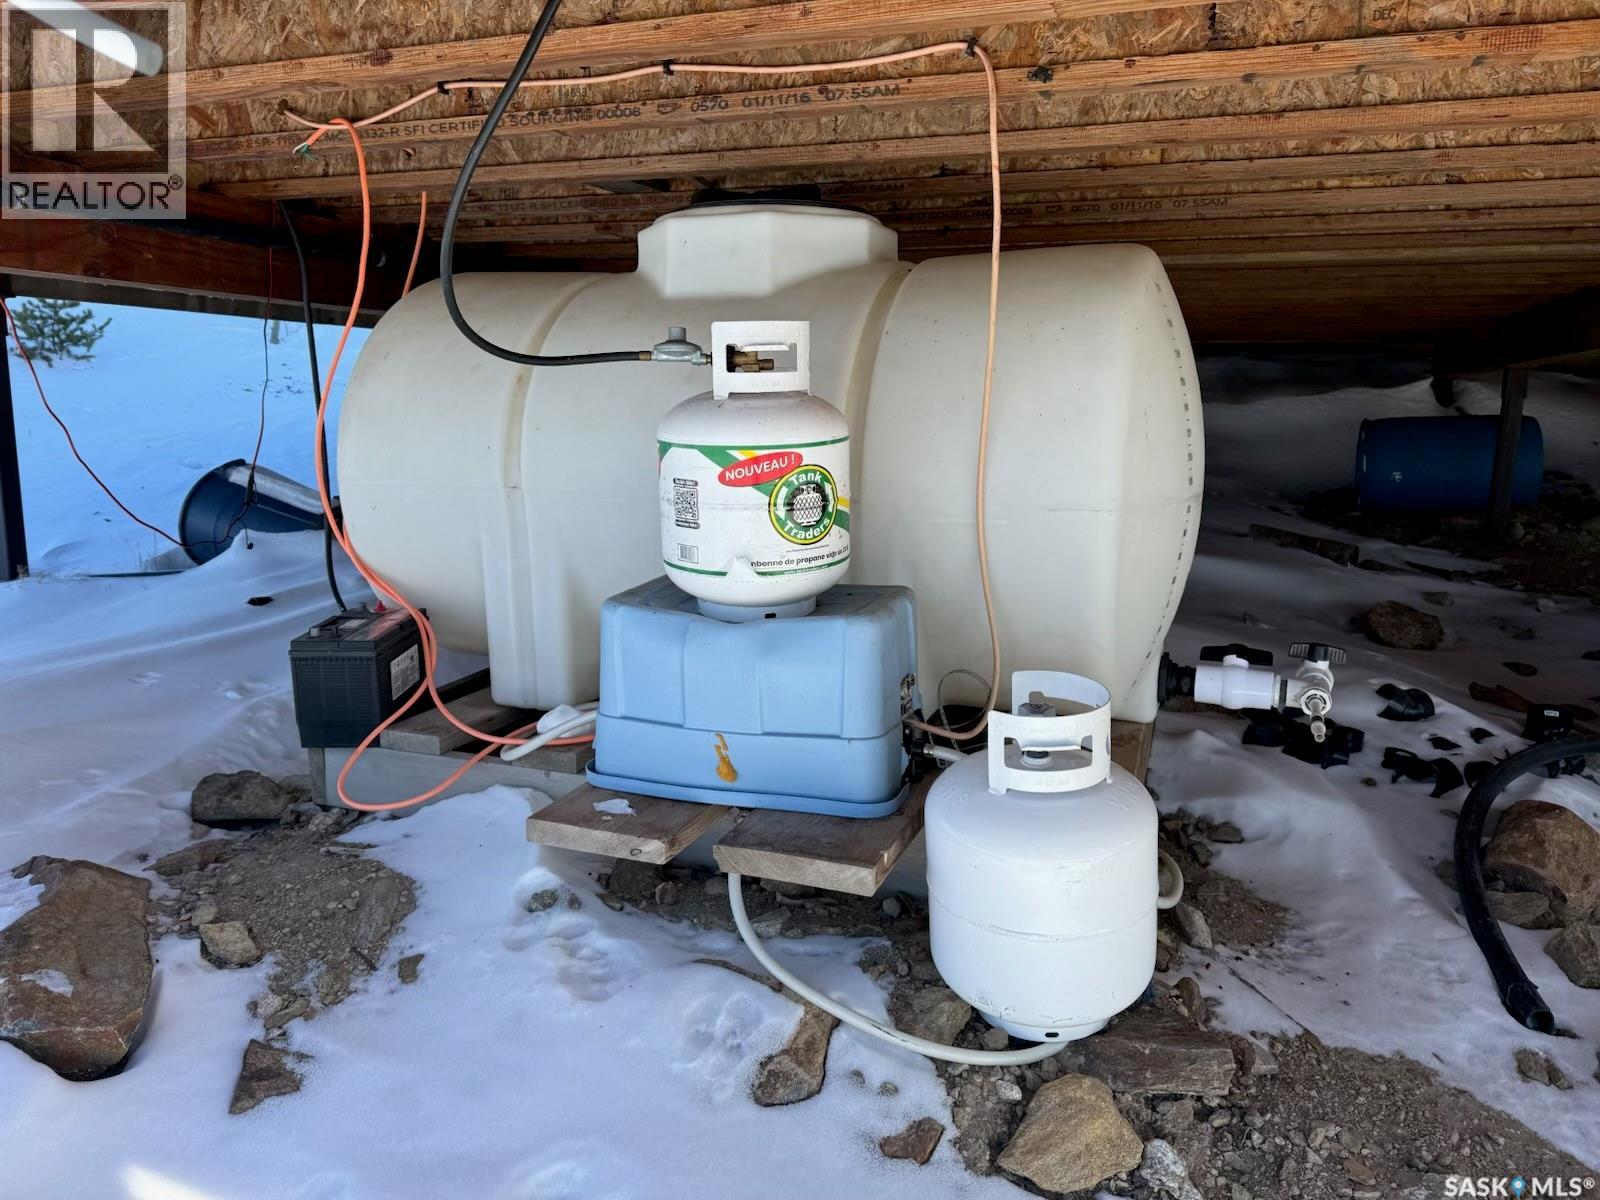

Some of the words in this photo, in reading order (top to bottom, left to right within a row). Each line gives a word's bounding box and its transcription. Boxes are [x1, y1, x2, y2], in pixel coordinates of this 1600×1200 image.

[1373, 7, 1397, 21] DEC
[404, 124, 425, 137] SFI
[428, 117, 504, 134] CERTIFID
[690, 97, 729, 112] 0570
[741, 91, 811, 109] 01/11/16
[724, 456, 788, 483] NOUVEAU
[788, 471, 823, 486] Tank
[783, 517, 831, 540] Traders
[795, 553, 826, 567] propane
